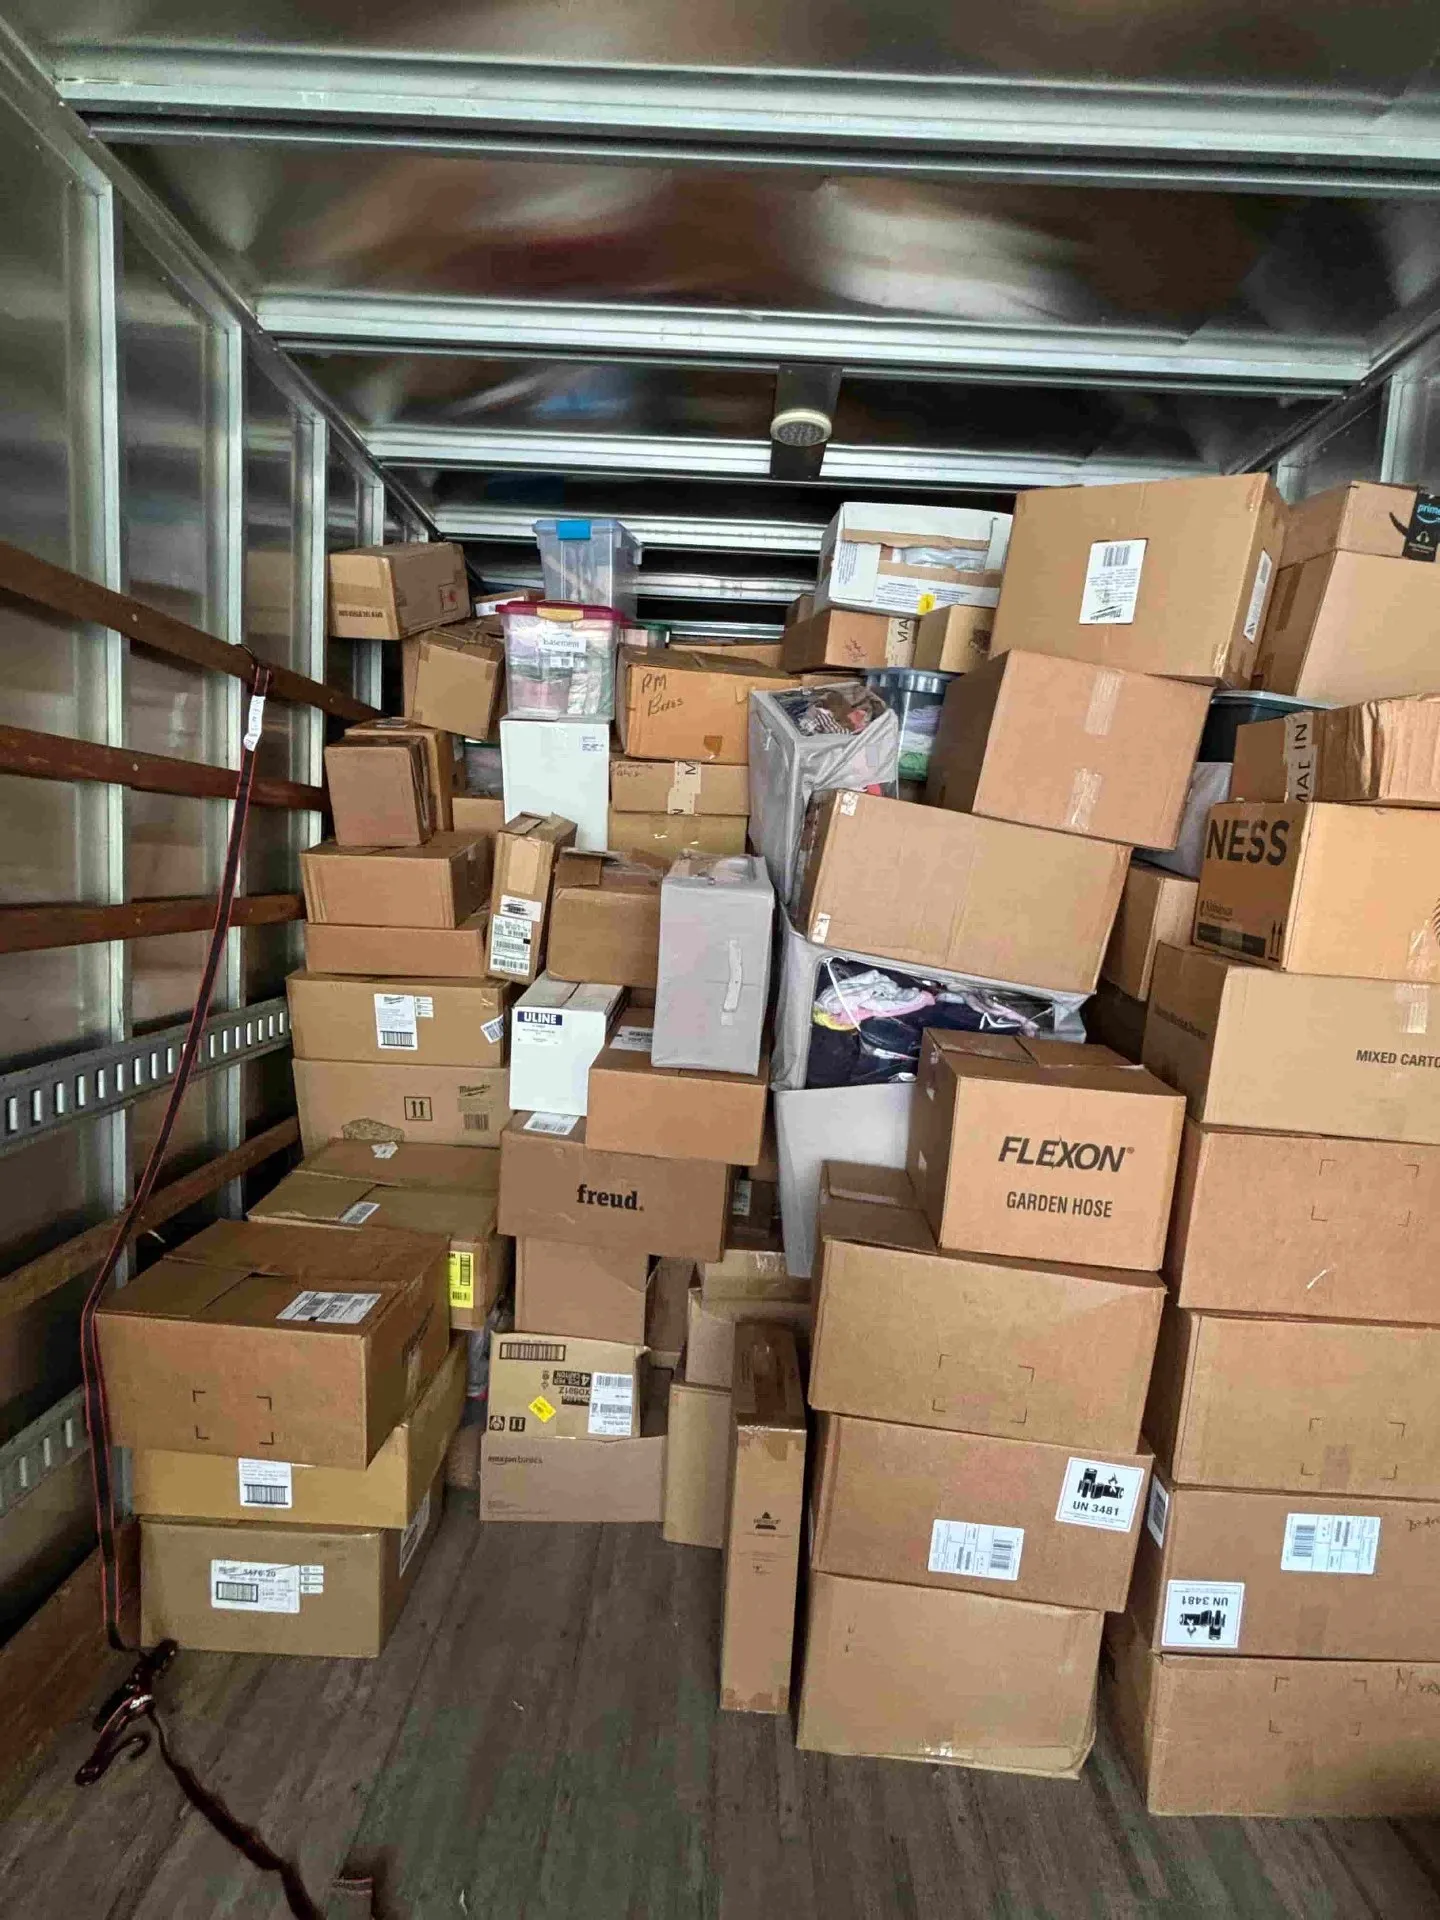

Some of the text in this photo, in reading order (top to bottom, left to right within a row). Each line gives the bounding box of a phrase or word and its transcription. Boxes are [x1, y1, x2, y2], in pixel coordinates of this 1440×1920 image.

[1205, 818, 1290, 867] NESS
[524, 1011, 558, 1024] ULINE
[1356, 1049, 1397, 1064] MIXED
[1006, 1191, 1113, 1218] GARDEN HOSE
[1072, 1500, 1119, 1516] UN 3481
[1182, 1595, 1229, 1606] UN 3481
